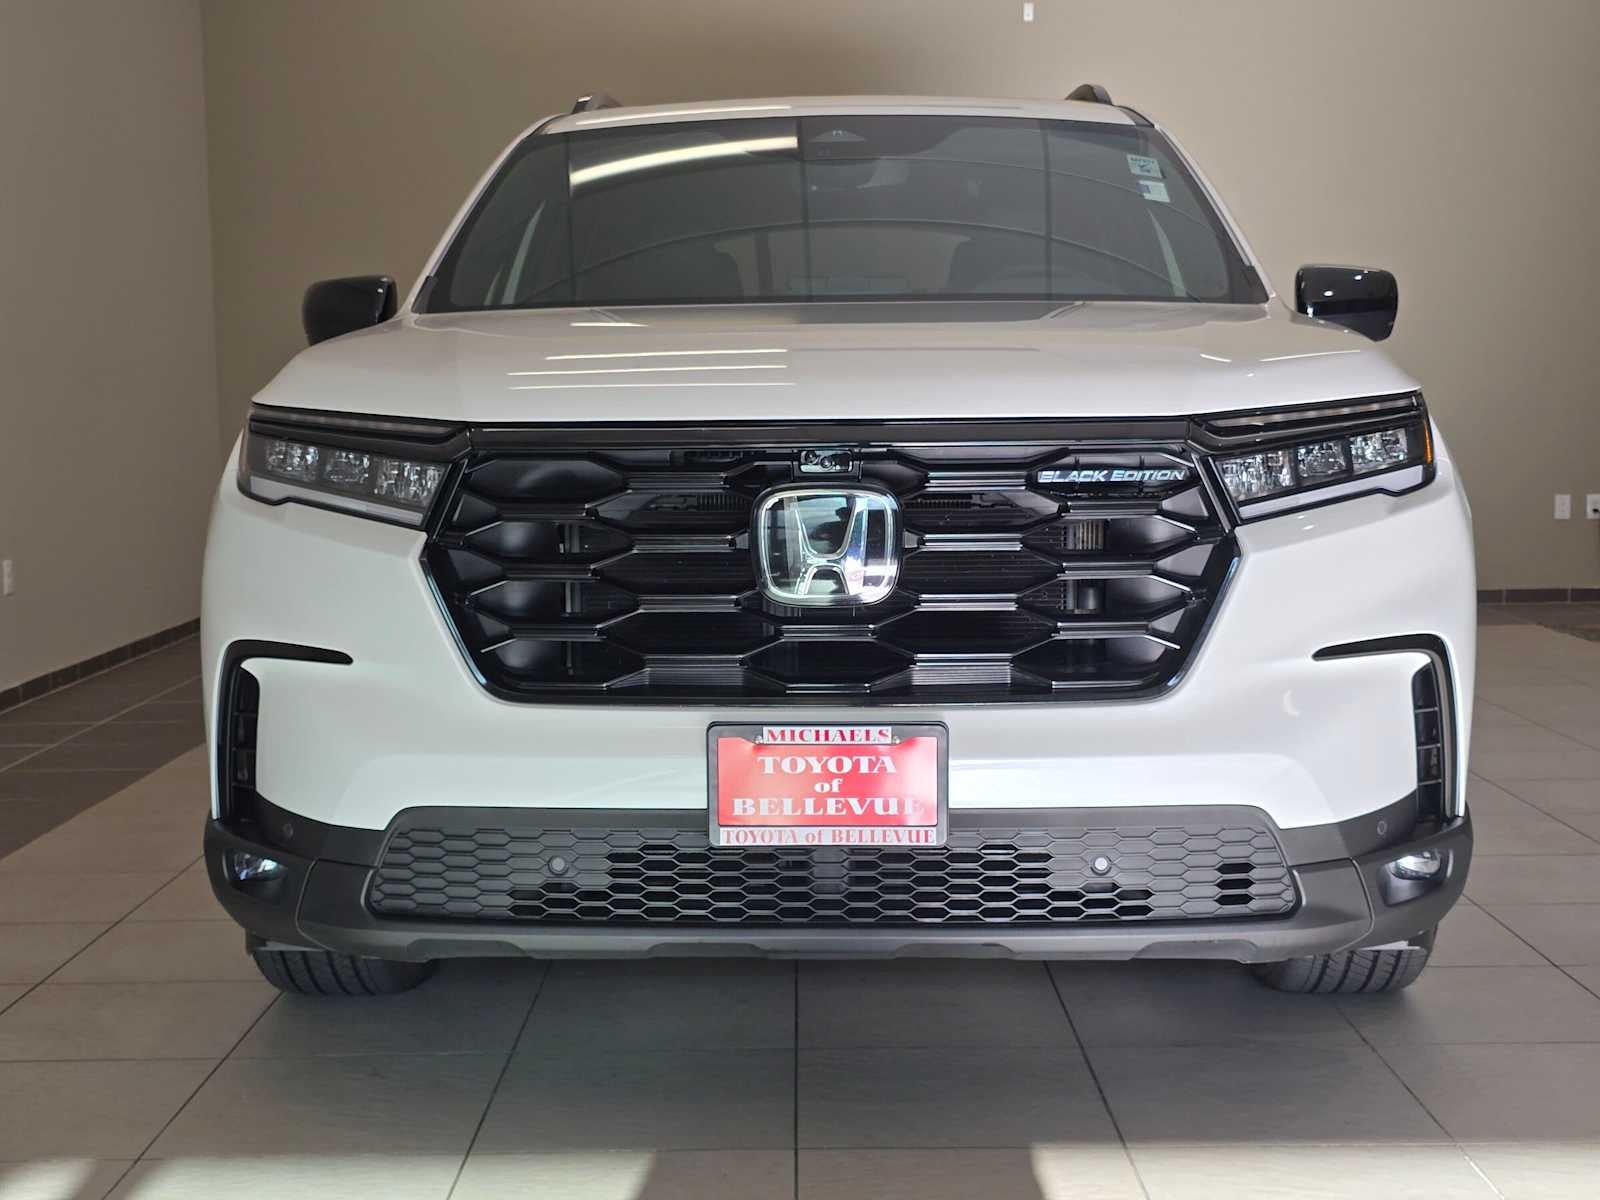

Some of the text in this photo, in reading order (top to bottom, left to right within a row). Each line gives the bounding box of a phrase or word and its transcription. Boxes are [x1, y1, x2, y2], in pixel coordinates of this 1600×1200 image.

[1038, 470, 1185, 483] BLACK EDITION
[766, 729, 890, 742] MICHAELS
[758, 756, 896, 774] TOYOTA
[814, 779, 843, 793] of
[732, 798, 924, 816] BELLEVUE
[723, 830, 935, 844] TOYOTA of BELLEVUE
